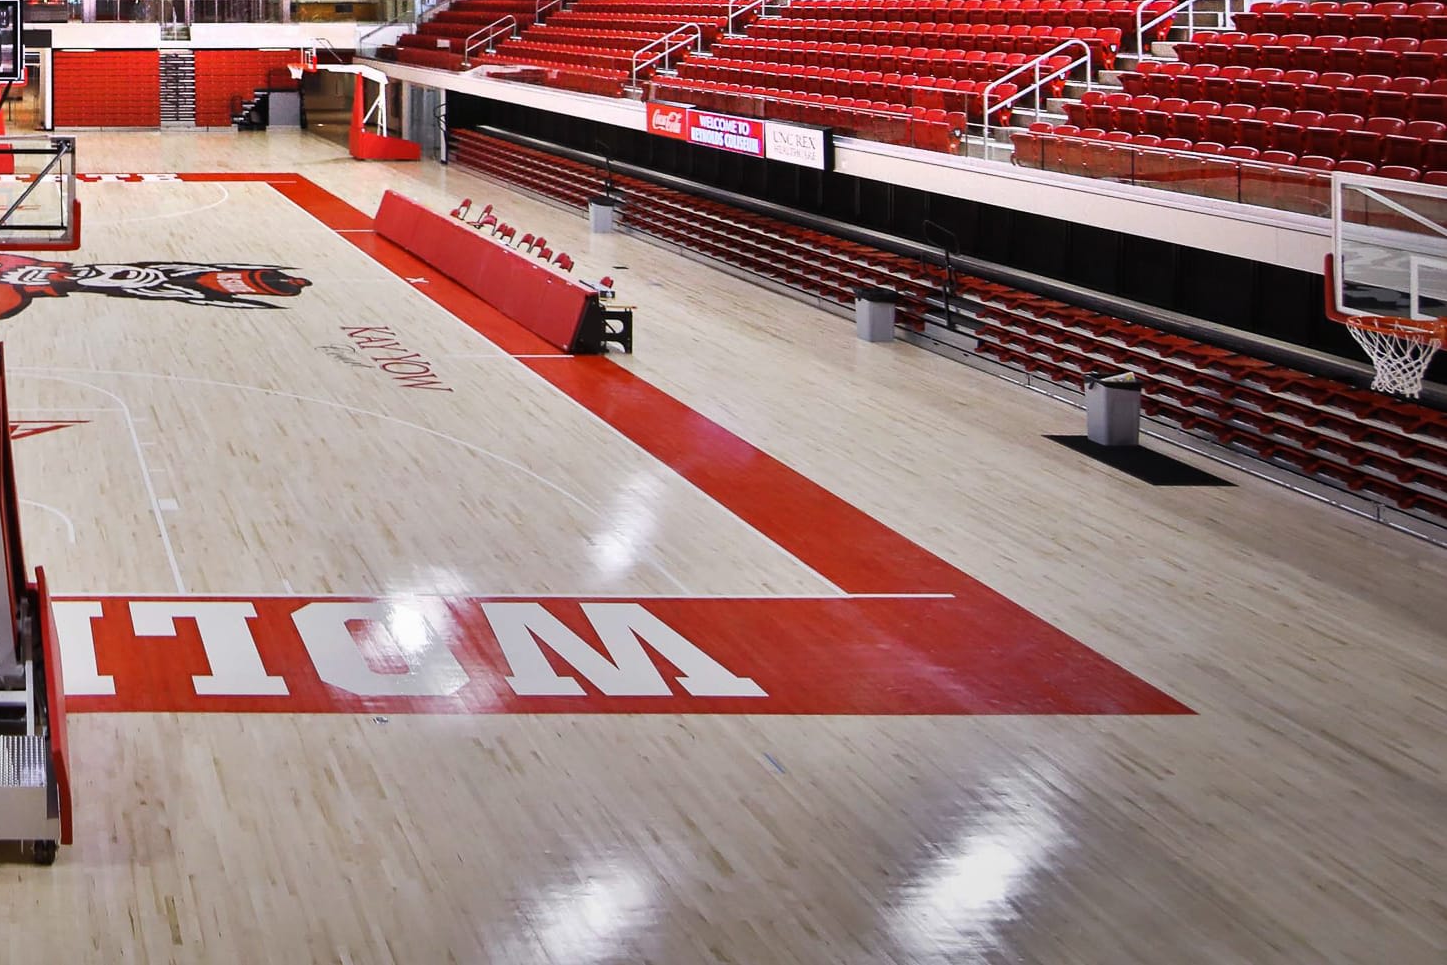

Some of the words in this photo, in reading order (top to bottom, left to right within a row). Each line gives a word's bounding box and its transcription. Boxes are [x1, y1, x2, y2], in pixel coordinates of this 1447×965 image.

[699, 115, 737, 134] WELCOME
[737, 122, 750, 136] TO
[340, 326, 409, 353] KAY
[371, 353, 455, 392] YOW
